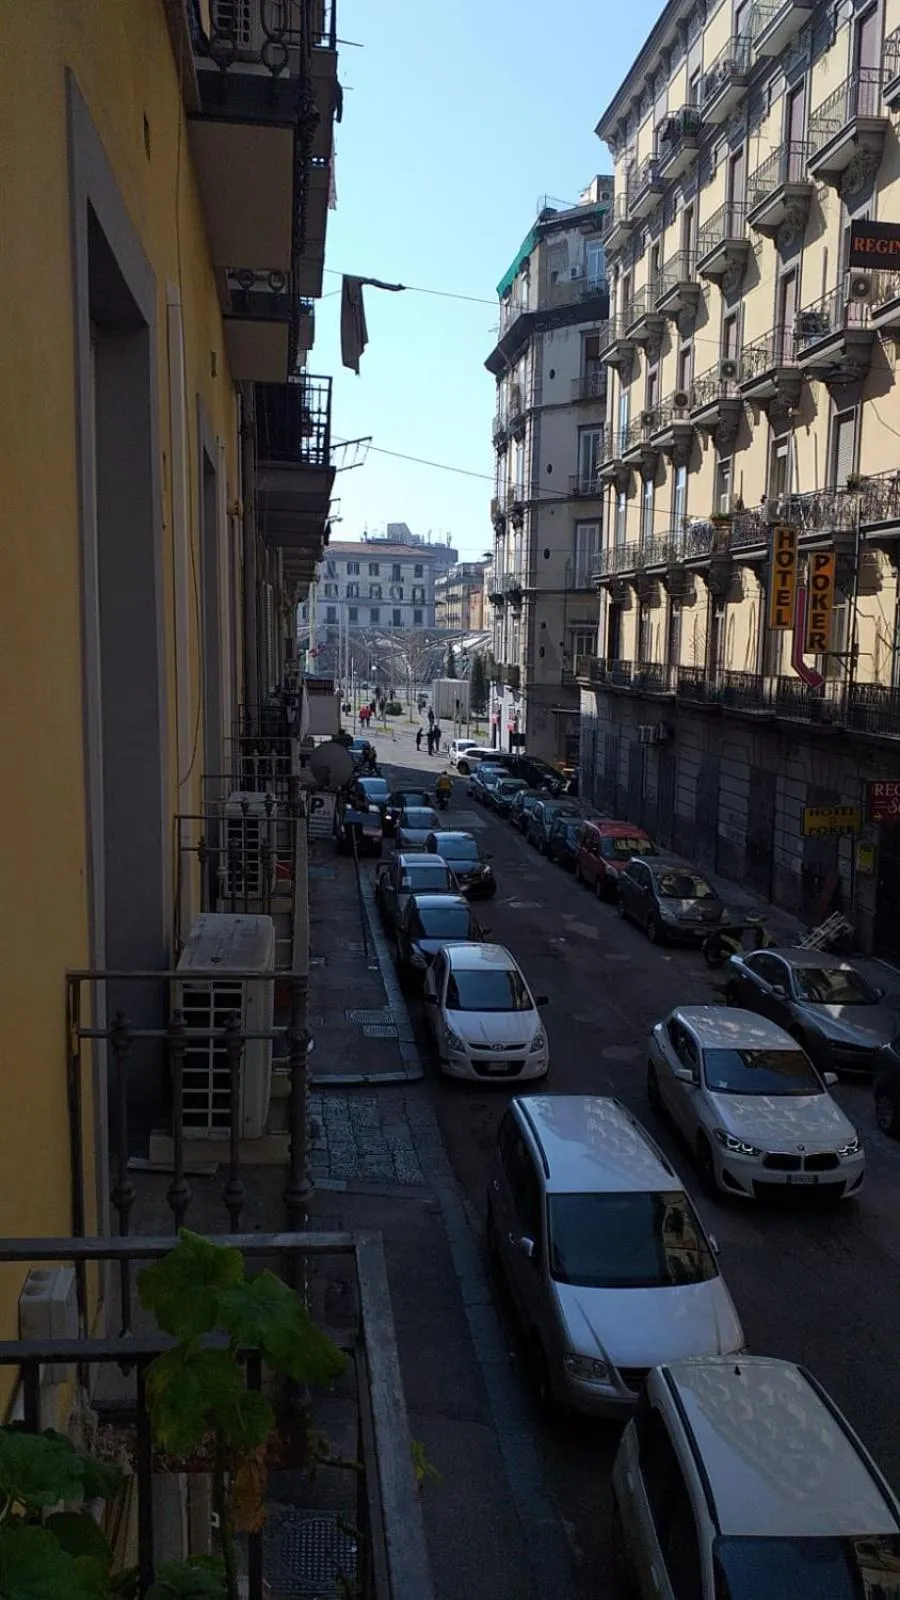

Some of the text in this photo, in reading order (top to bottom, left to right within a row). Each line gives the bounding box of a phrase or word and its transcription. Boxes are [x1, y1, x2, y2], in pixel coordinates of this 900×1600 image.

[775, 530, 794, 626] HOTEL
[808, 554, 831, 650] POKER
[311, 798, 324, 814] P
[809, 807, 857, 817] HOTEL
[808, 825, 855, 836] POKER
